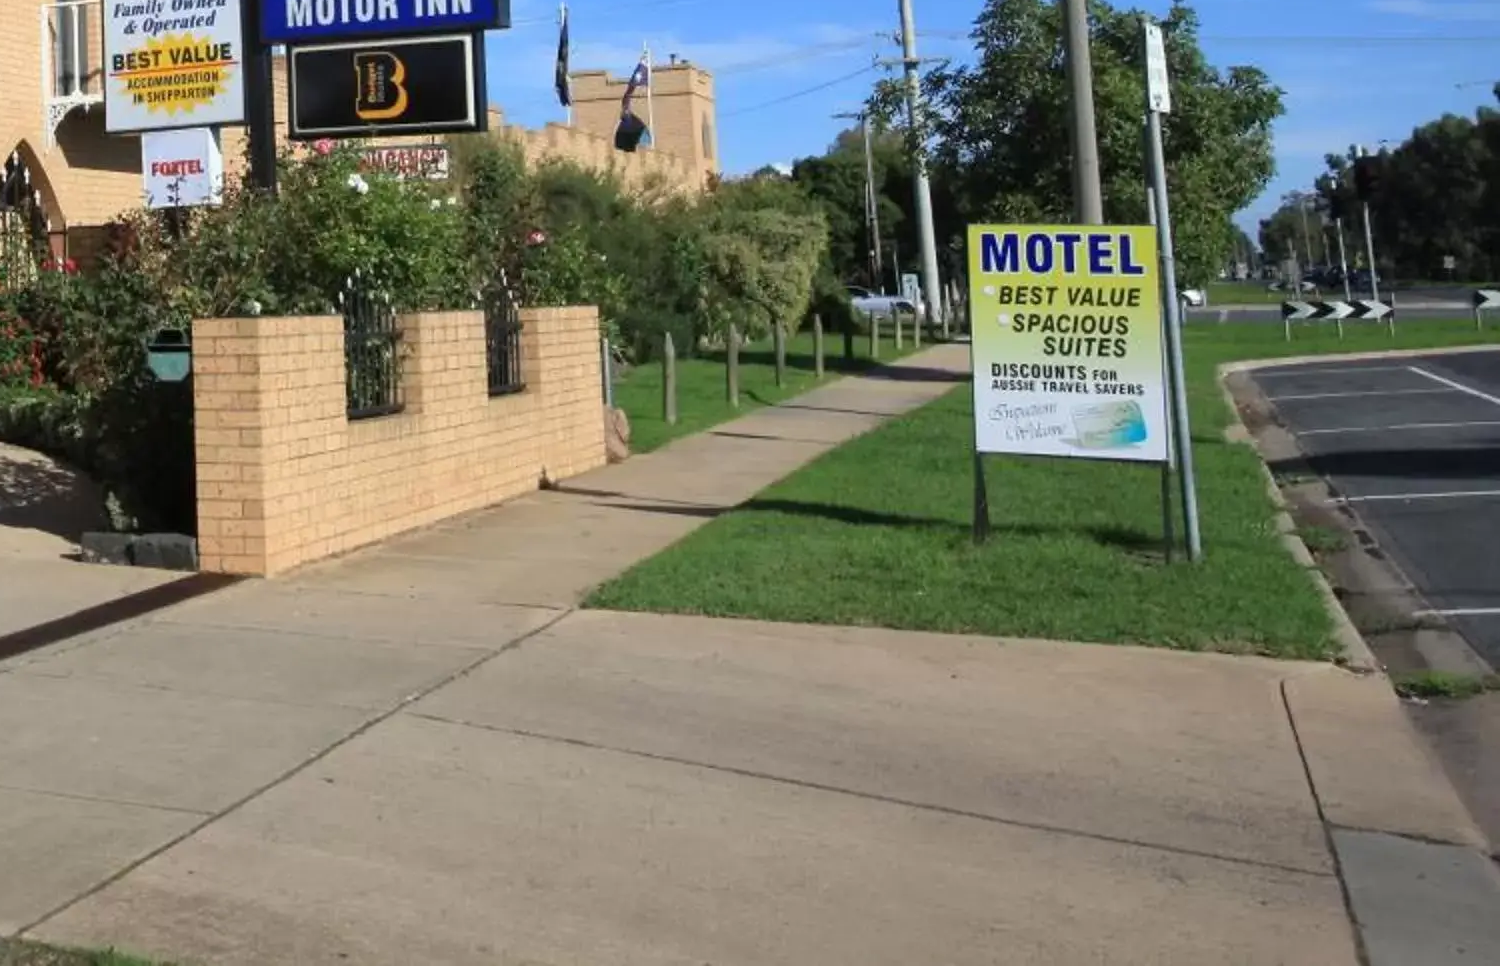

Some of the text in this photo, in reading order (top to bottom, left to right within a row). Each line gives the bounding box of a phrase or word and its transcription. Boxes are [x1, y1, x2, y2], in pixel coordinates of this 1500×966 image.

[123, 10, 217, 37] & Operated
[112, 42, 233, 72] BEST VALUE
[127, 71, 219, 91] ACCOMMODATION
[132, 86, 216, 105] IN SHEPPARTON
[151, 158, 205, 178] FOXTEL
[980, 233, 1144, 275] MOTEL
[999, 286, 1142, 308] BEST VALUE
[1012, 313, 1130, 335] SPACIOUS
[1042, 337, 1128, 358] SUITES
[991, 363, 1118, 382] DISCOUNTS FOR
[991, 379, 1145, 396] AUSSIE TRAVEL SAVERS
